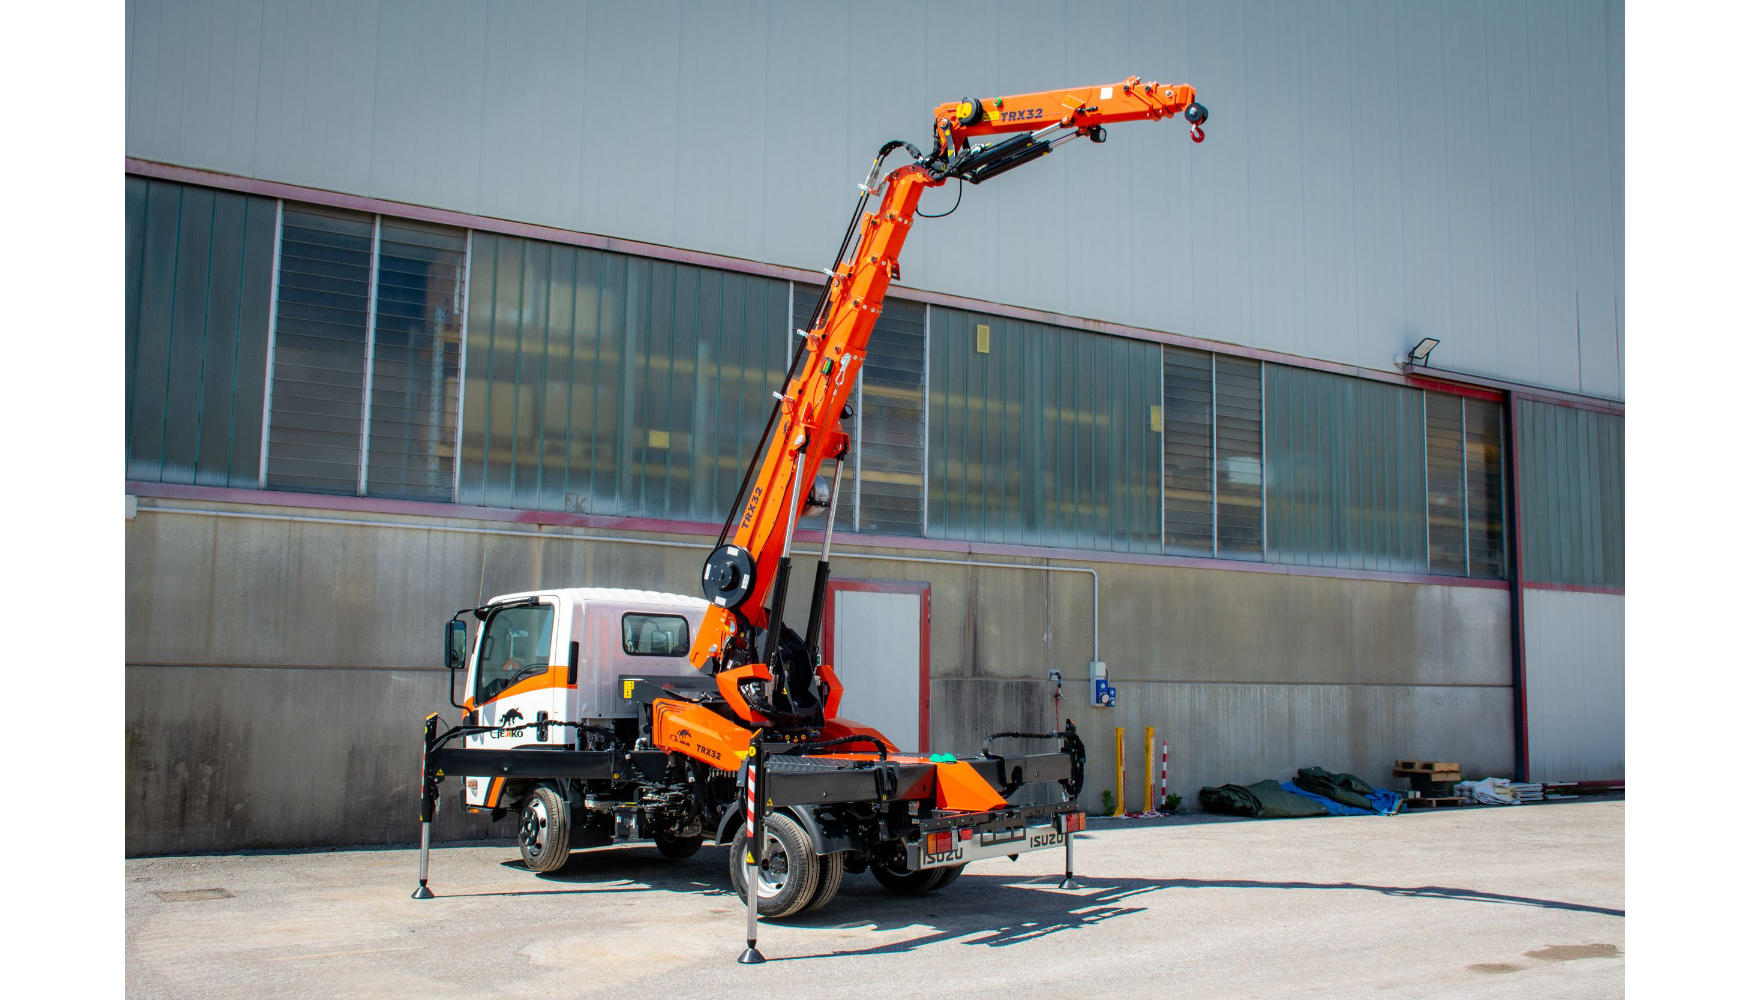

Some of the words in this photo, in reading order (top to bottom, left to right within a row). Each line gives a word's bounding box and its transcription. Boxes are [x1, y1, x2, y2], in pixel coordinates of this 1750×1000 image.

[1001, 108, 1043, 122] TRX32
[741, 486, 763, 529] TRX32
[696, 744, 722, 760] TRX32
[1030, 833, 1064, 848] ISUZU
[923, 847, 963, 865] ISUZU
